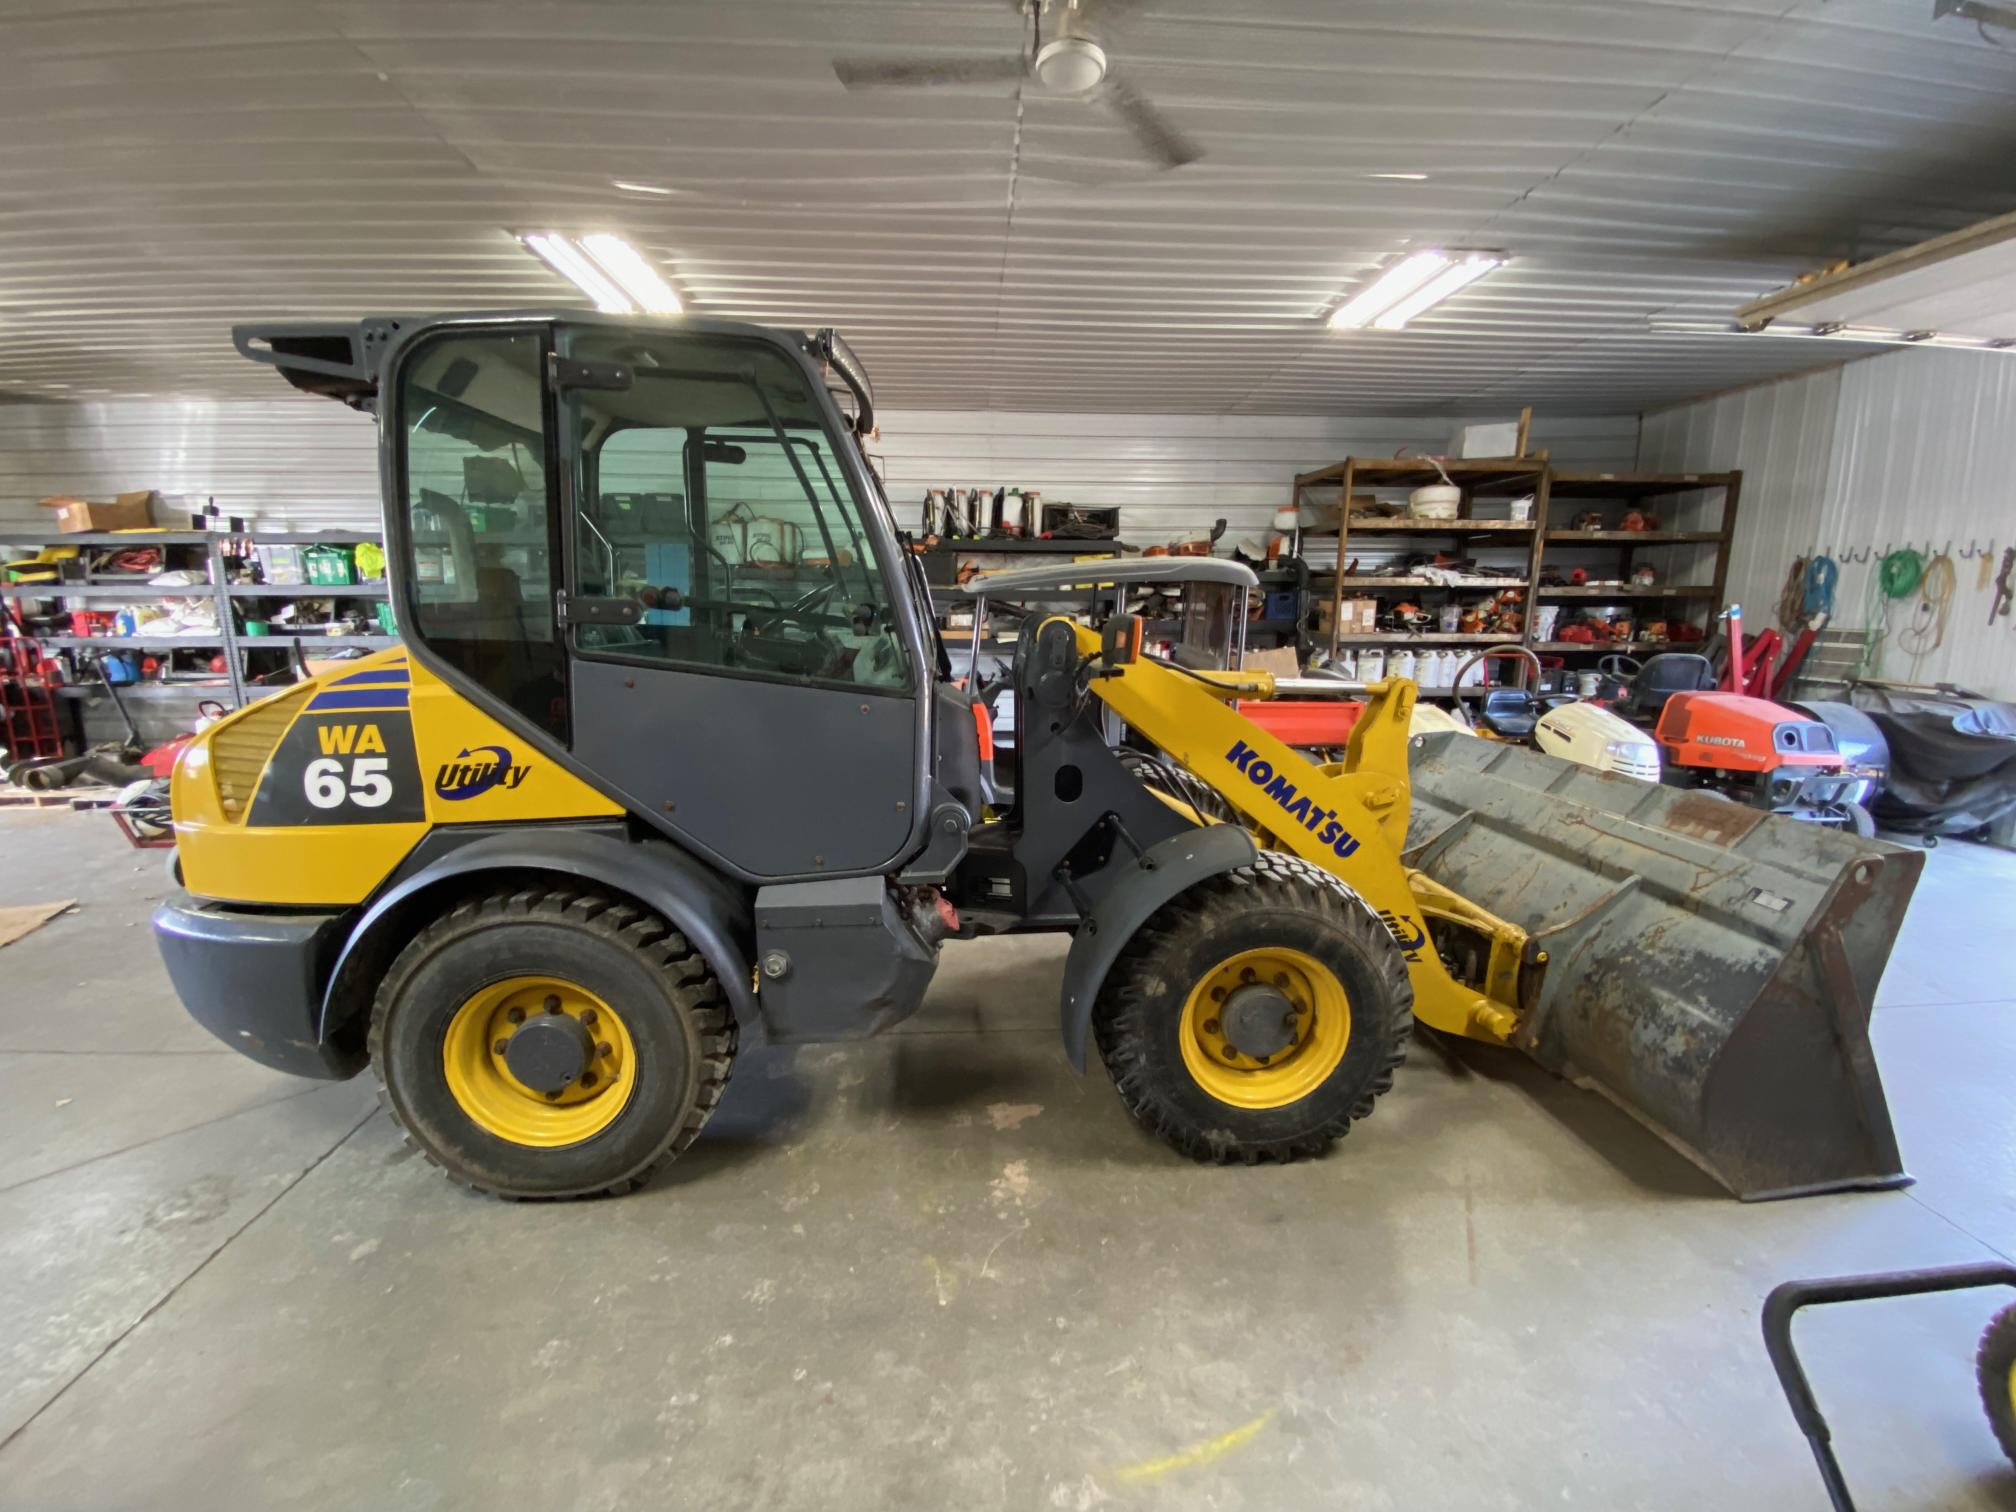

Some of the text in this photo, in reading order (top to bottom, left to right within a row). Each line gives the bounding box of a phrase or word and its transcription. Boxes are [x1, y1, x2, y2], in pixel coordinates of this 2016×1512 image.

[318, 724, 386, 755] WA
[1696, 735, 1745, 748] KUBOTA
[304, 757, 393, 809] 65
[435, 762, 532, 789] Utility
[1225, 739, 1360, 858] KOMATSU
